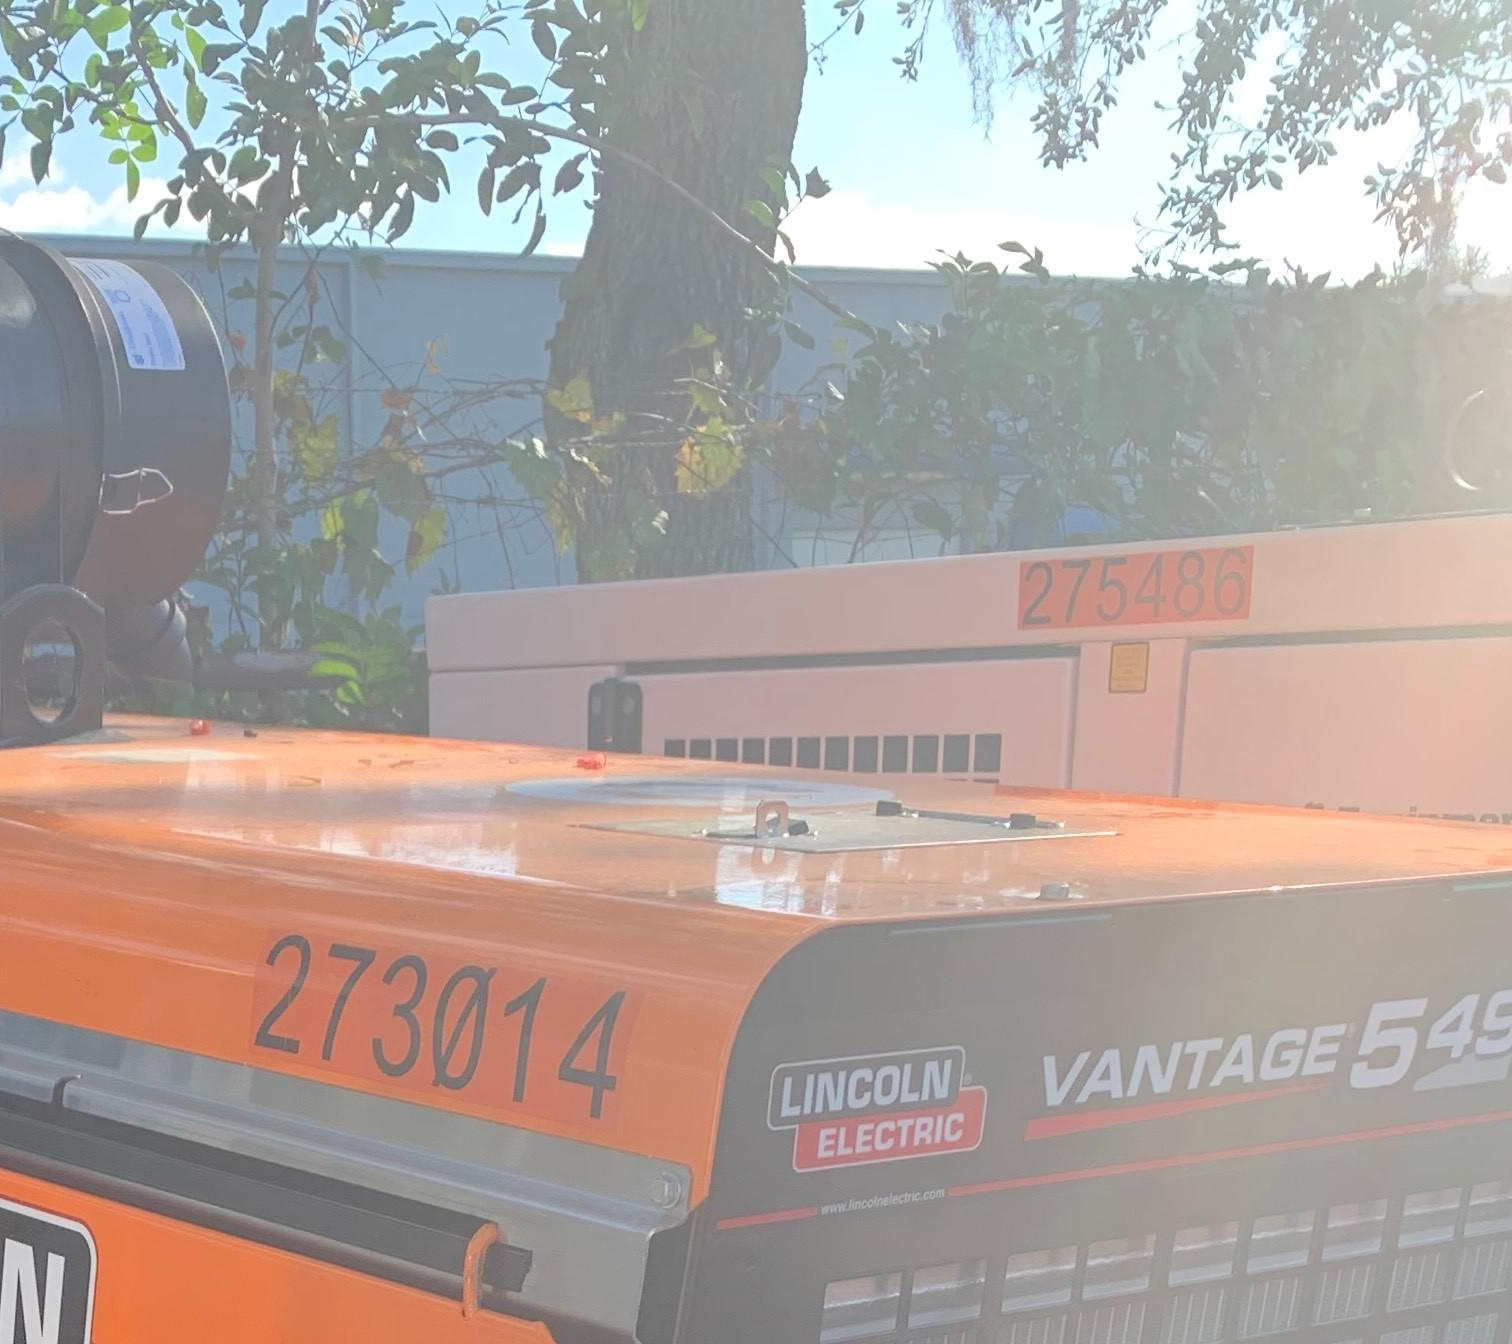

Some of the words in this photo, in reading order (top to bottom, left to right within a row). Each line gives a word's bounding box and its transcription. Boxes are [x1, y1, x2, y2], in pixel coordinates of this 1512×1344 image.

[1022, 548, 1248, 625] 275486
[254, 935, 627, 1119] 273014
[780, 1059, 953, 1118] LINCOLN
[1042, 1023, 1347, 1107] VANTAGE
[817, 1112, 965, 1159] ELECTRIC
[820, 1188, 945, 1216] www.lincolnelectric.com
